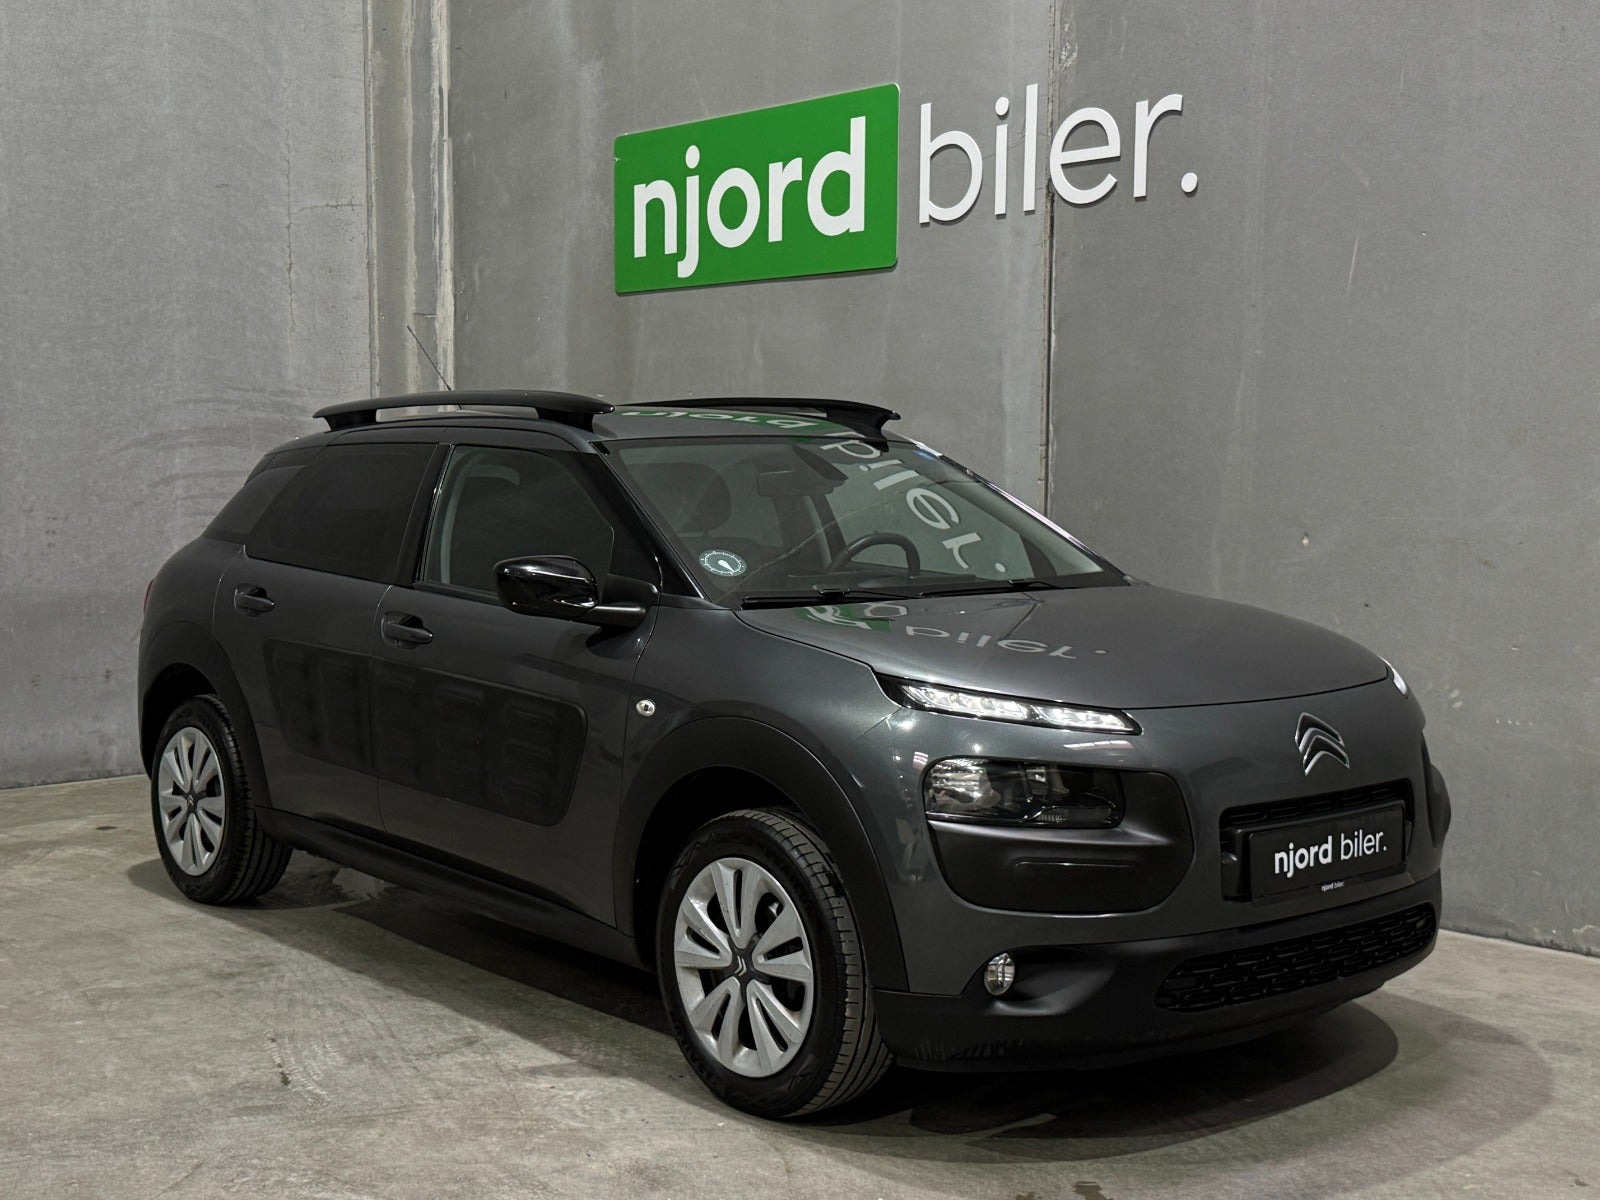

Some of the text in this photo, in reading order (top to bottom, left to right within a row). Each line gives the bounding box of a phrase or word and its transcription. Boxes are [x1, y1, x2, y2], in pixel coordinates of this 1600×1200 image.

[633, 84, 1198, 278] njord biler.
[1274, 829, 1387, 878] njord biler.
